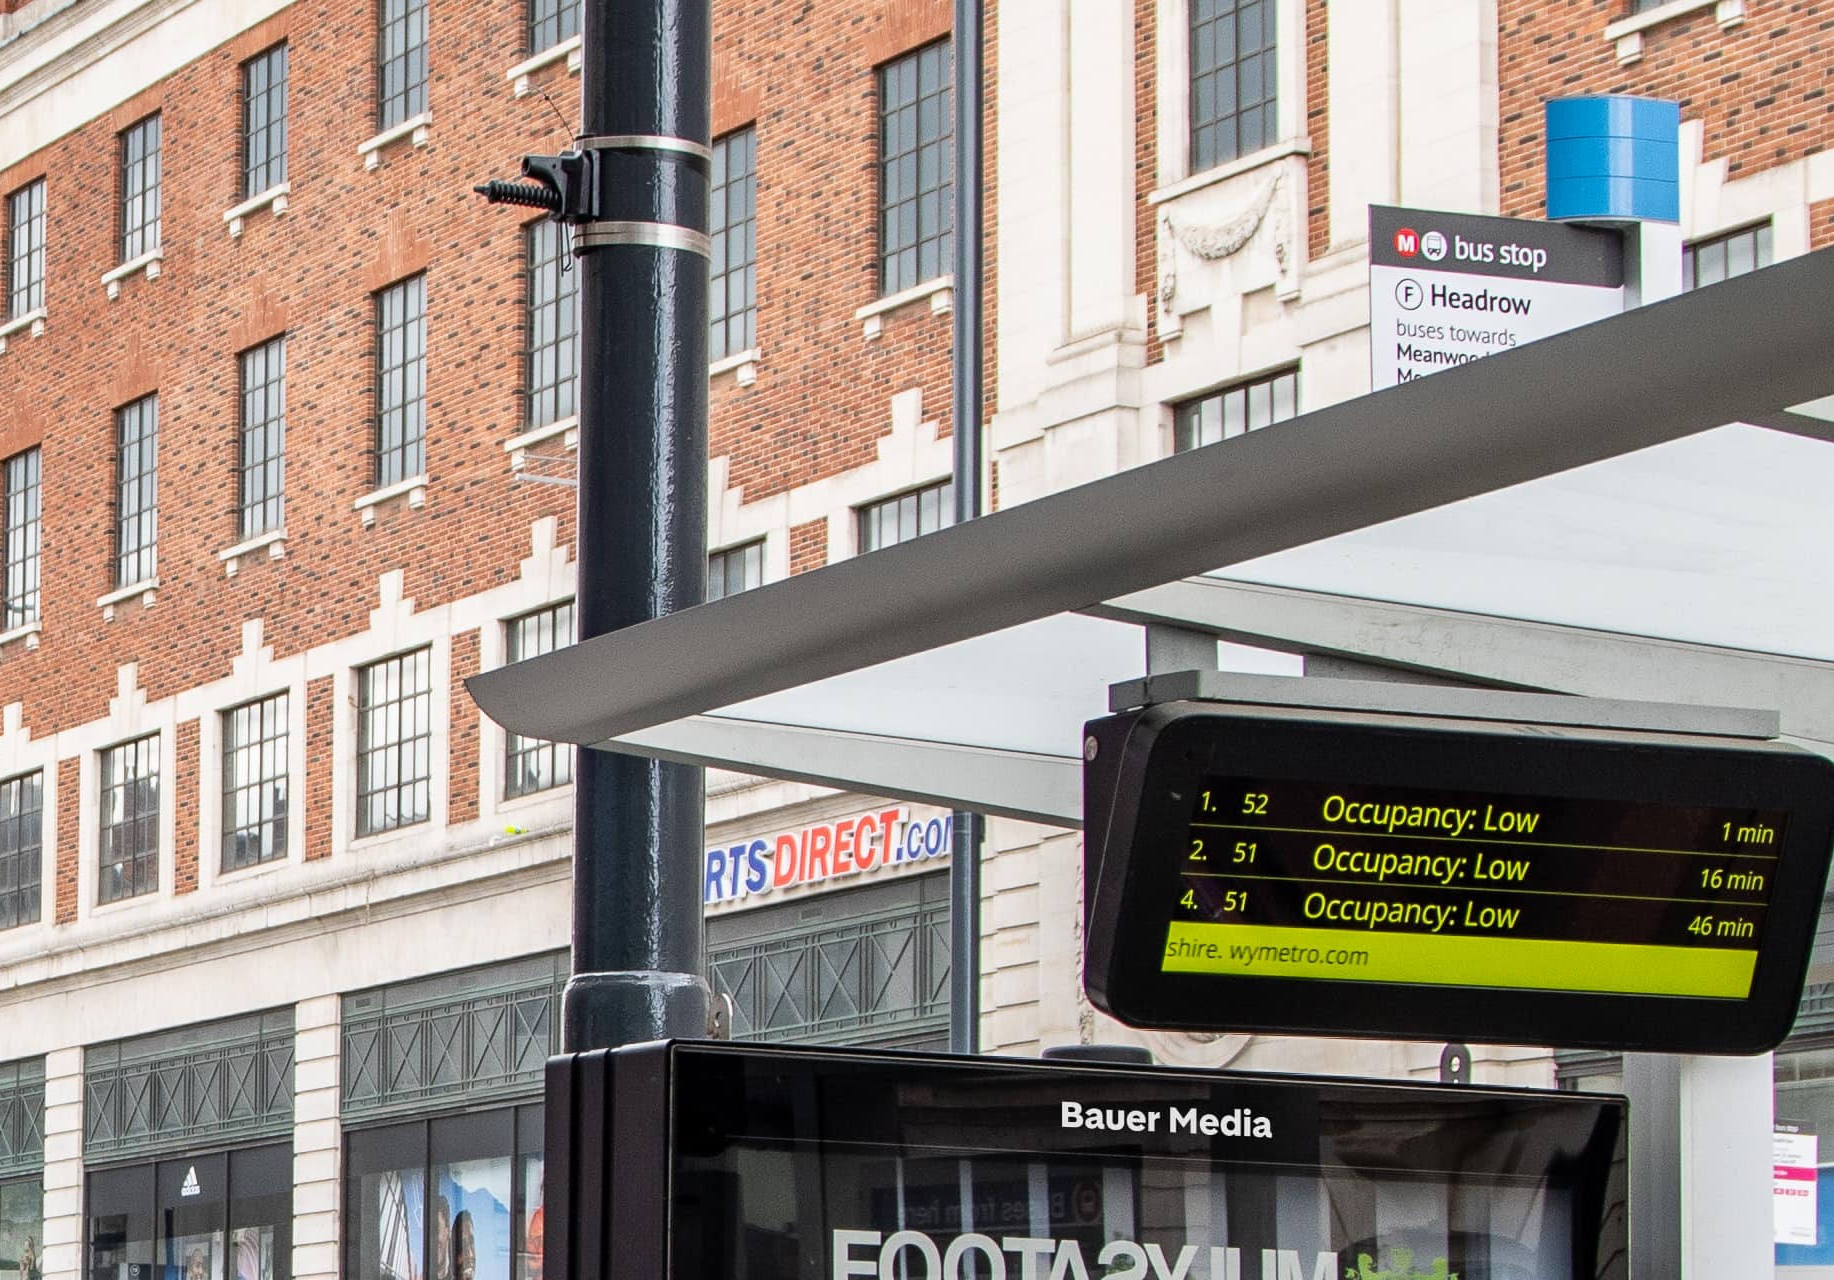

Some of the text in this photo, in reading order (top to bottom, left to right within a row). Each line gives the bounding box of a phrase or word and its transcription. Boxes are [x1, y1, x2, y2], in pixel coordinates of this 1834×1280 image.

[1455, 235, 1547, 273] bus stop
[1404, 283, 1532, 315] F Headrow
[1397, 318, 1516, 347] buses towards
[1201, 791, 1774, 845] 1. 52 Occupancy: Low 1 min
[1188, 839, 1765, 892] 2. 51 Occupancy: Low 16 min
[1179, 888, 1755, 938] 4. 51 Occupancy: Low 46 min
[1166, 937, 1369, 967] shire. wymetro.com
[1060, 1101, 1273, 1139] Bauer Media
